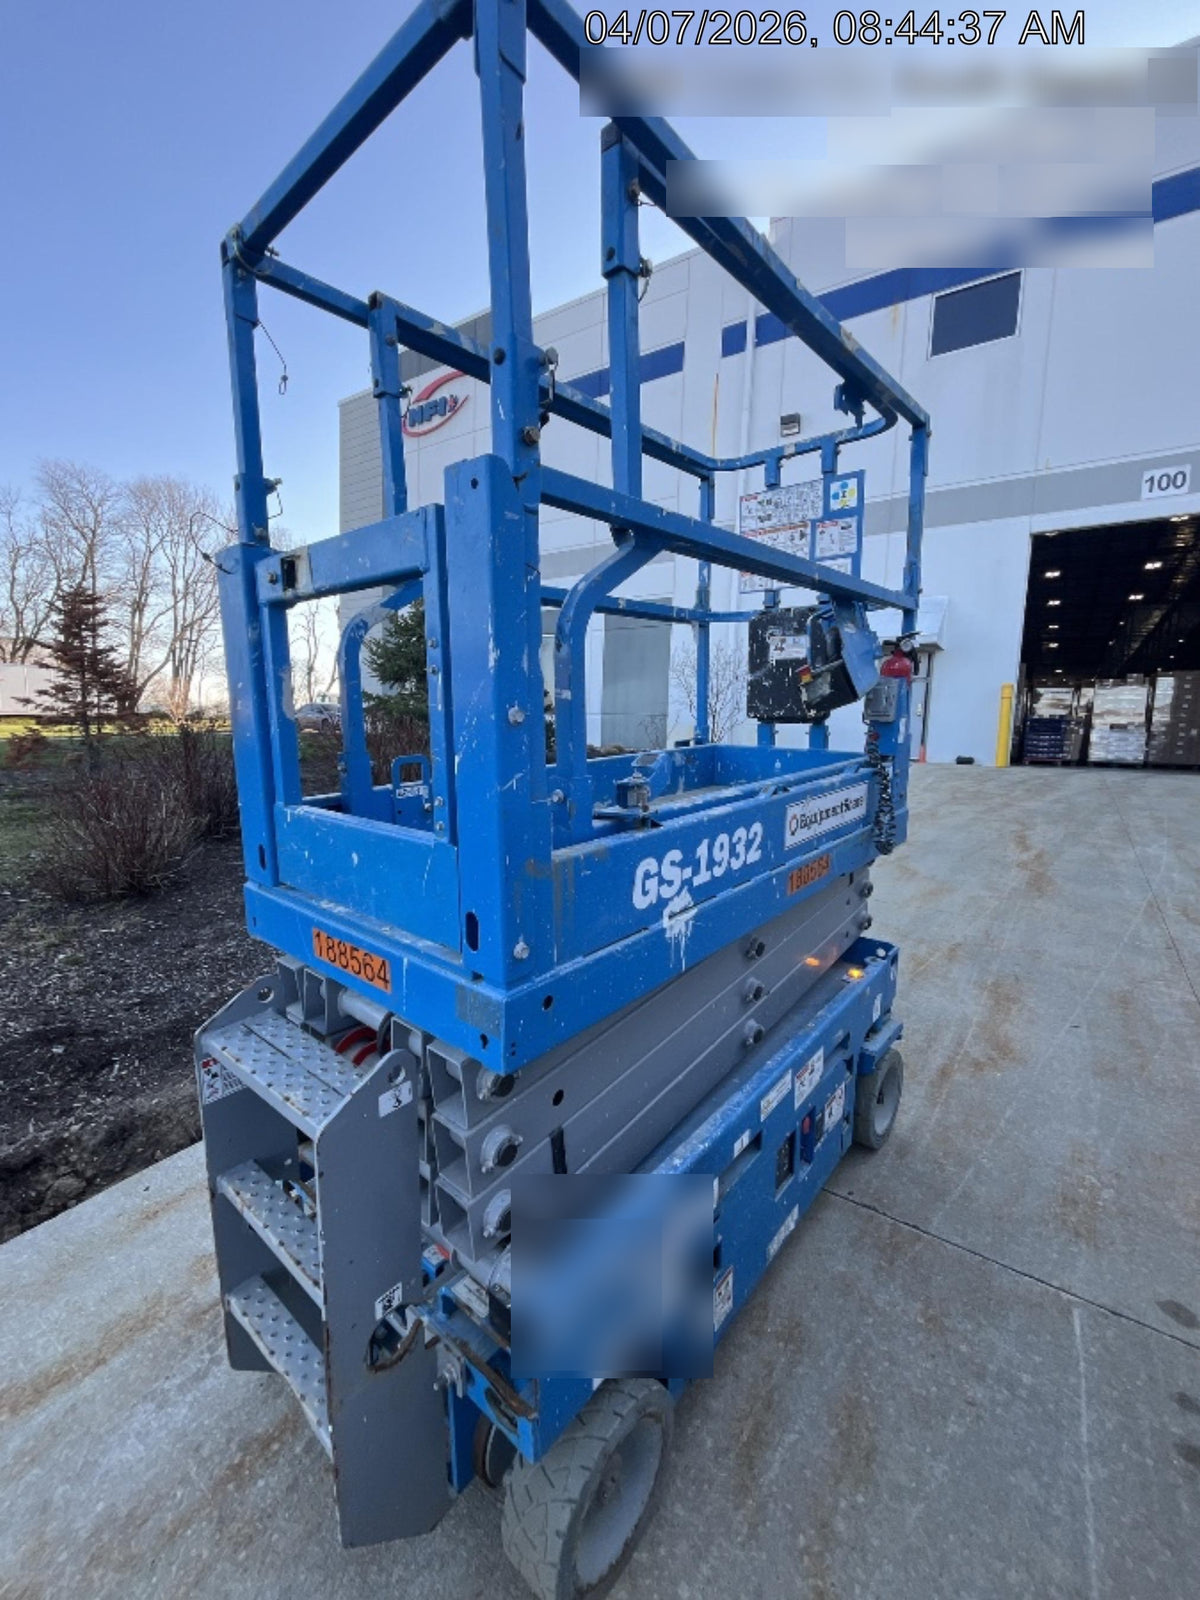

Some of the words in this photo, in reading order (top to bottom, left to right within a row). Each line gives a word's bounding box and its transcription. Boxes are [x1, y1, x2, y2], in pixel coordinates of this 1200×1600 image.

[1145, 470, 1187, 493] 100
[632, 821, 763, 910] GS-1932
[315, 931, 390, 990] 188564
